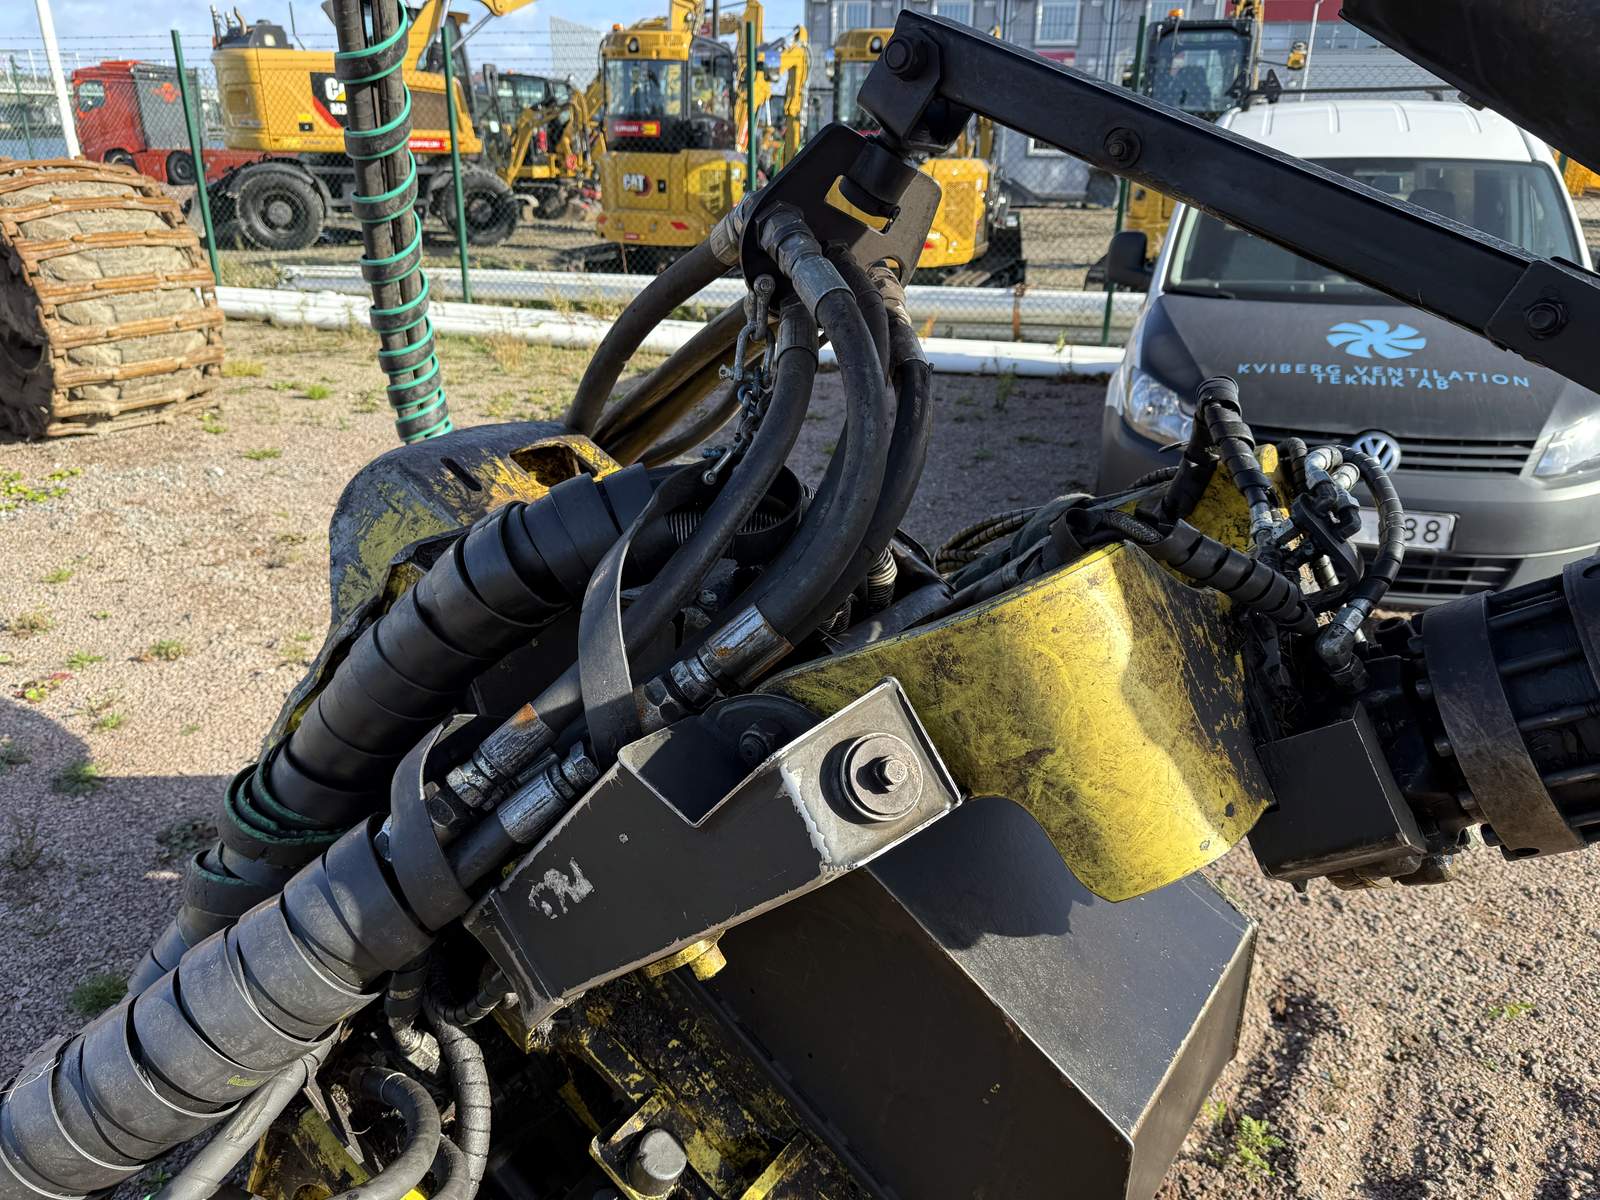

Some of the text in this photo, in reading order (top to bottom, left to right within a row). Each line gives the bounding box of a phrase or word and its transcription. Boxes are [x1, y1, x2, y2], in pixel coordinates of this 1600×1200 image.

[623, 173, 645, 192] CAT
[1237, 362, 1530, 388] KVIBERG VENTILATION
[1314, 373, 1450, 390] TEKNIK AB
